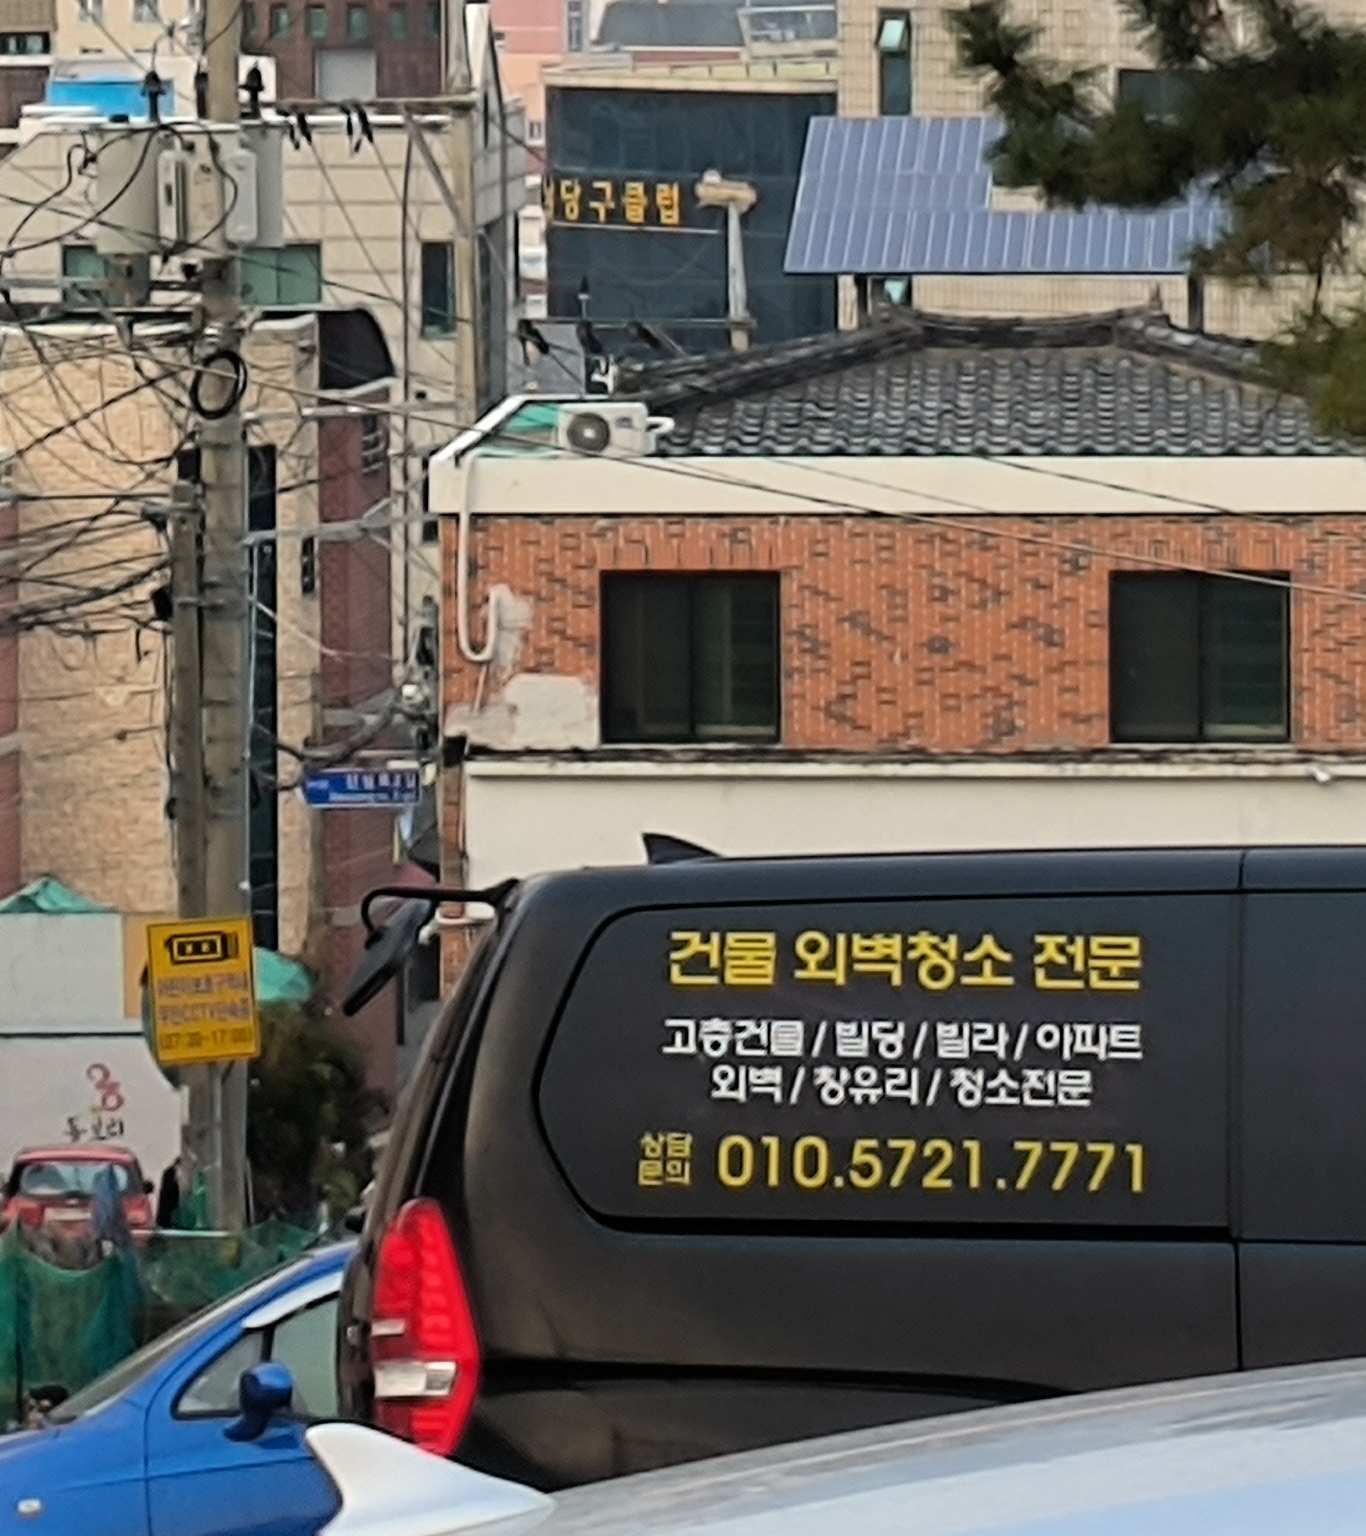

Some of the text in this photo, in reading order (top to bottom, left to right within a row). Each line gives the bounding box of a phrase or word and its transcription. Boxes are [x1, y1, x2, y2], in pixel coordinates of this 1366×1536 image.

[669, 930, 1142, 991] 건물 외벽청소 전문
[661, 1017, 805, 1058] 고층건물
[835, 1020, 906, 1059] 빌딩
[936, 1021, 1010, 1061] 빌라
[1035, 1022, 1143, 1062] 아파트
[711, 1064, 783, 1103] 외벽
[813, 1065, 920, 1106] 창유리
[949, 1067, 1093, 1108] 청소전문
[717, 1135, 1145, 1193] 010.5721.7771
